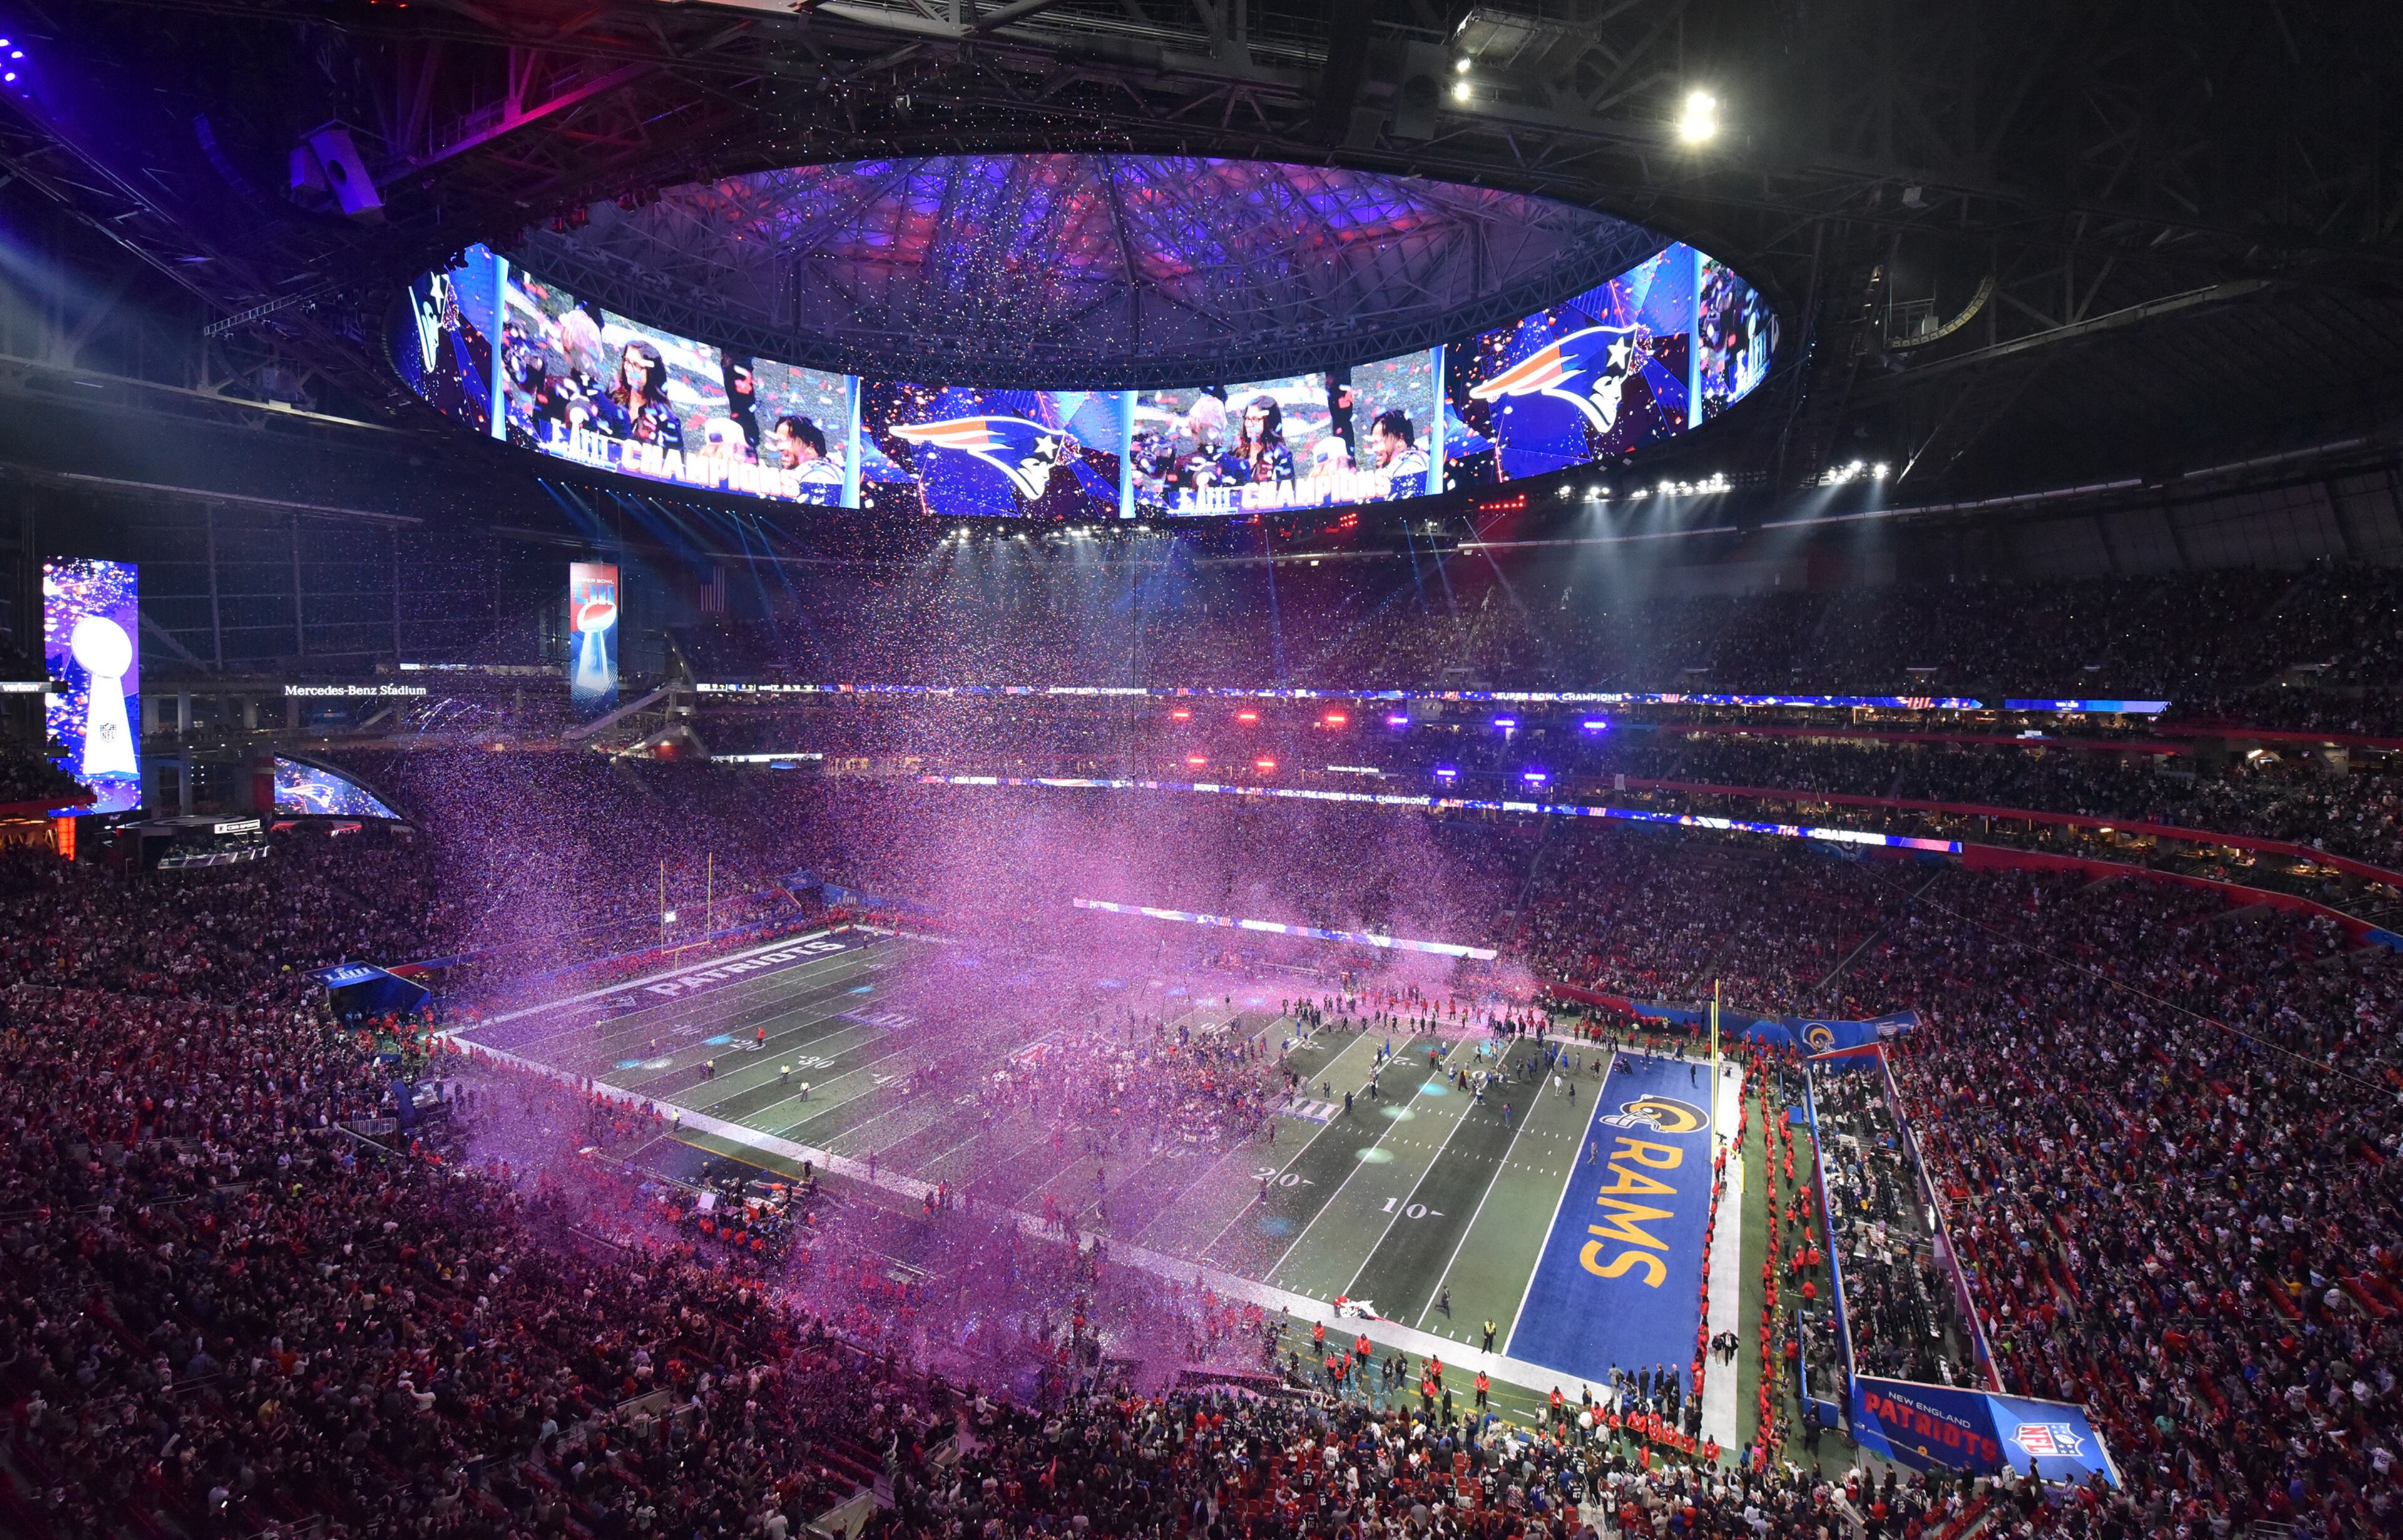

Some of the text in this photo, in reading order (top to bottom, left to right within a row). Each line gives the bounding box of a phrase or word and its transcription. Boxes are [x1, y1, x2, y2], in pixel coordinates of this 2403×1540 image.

[621, 439, 800, 497] CHAMPIONS
[1242, 468, 1391, 509] CHAMPIONS
[3, 683, 39, 692] verizon
[285, 685, 426, 696] Mercedes-Benz Stadium
[1496, 693, 1622, 701] SUPER BOWL CHAMPIONS
[102, 732, 115, 740] NFL
[1349, 793, 1374, 802] BOWL
[1376, 795, 1431, 805] CHAMPIONS
[645, 941, 846, 997] PATRIOTS
[798, 1056, 835, 1069] 30
[1252, 1166, 1300, 1188] 20
[1379, 1197, 1428, 1220] 10
[1579, 1136, 1684, 1288] RAMS
[1889, 1390, 1971, 1429] NEW ENGLAND
[1864, 1391, 1997, 1463] PATRIOTS
[2020, 1426, 2054, 1452] NFL
[1303, 1477, 1312, 1486] 87
[1485, 1486, 1495, 1495] 12
[1320, 1497, 1327, 1506] 12
[1897, 1504, 1906, 1513] 12
[1307, 1520, 1315, 1529] 12
